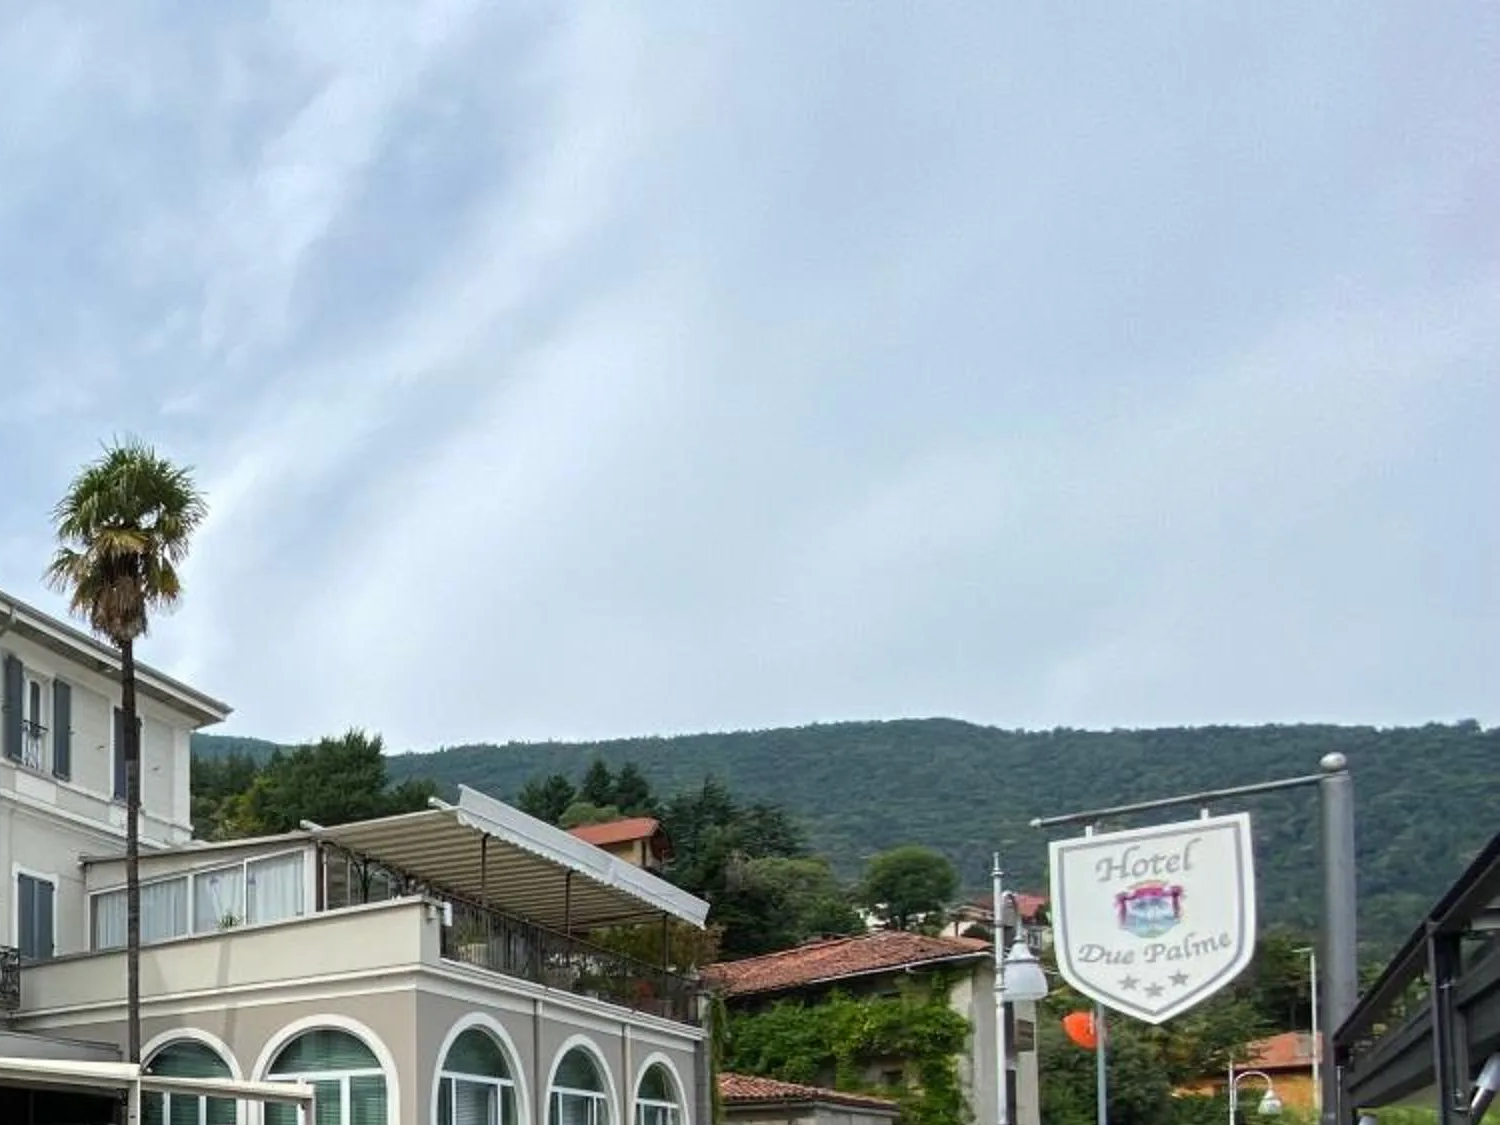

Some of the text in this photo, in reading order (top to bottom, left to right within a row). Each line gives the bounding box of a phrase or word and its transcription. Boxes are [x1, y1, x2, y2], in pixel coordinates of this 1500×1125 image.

[1096, 838, 1202, 882] Hotel
[1078, 931, 1232, 964] Due Palme
